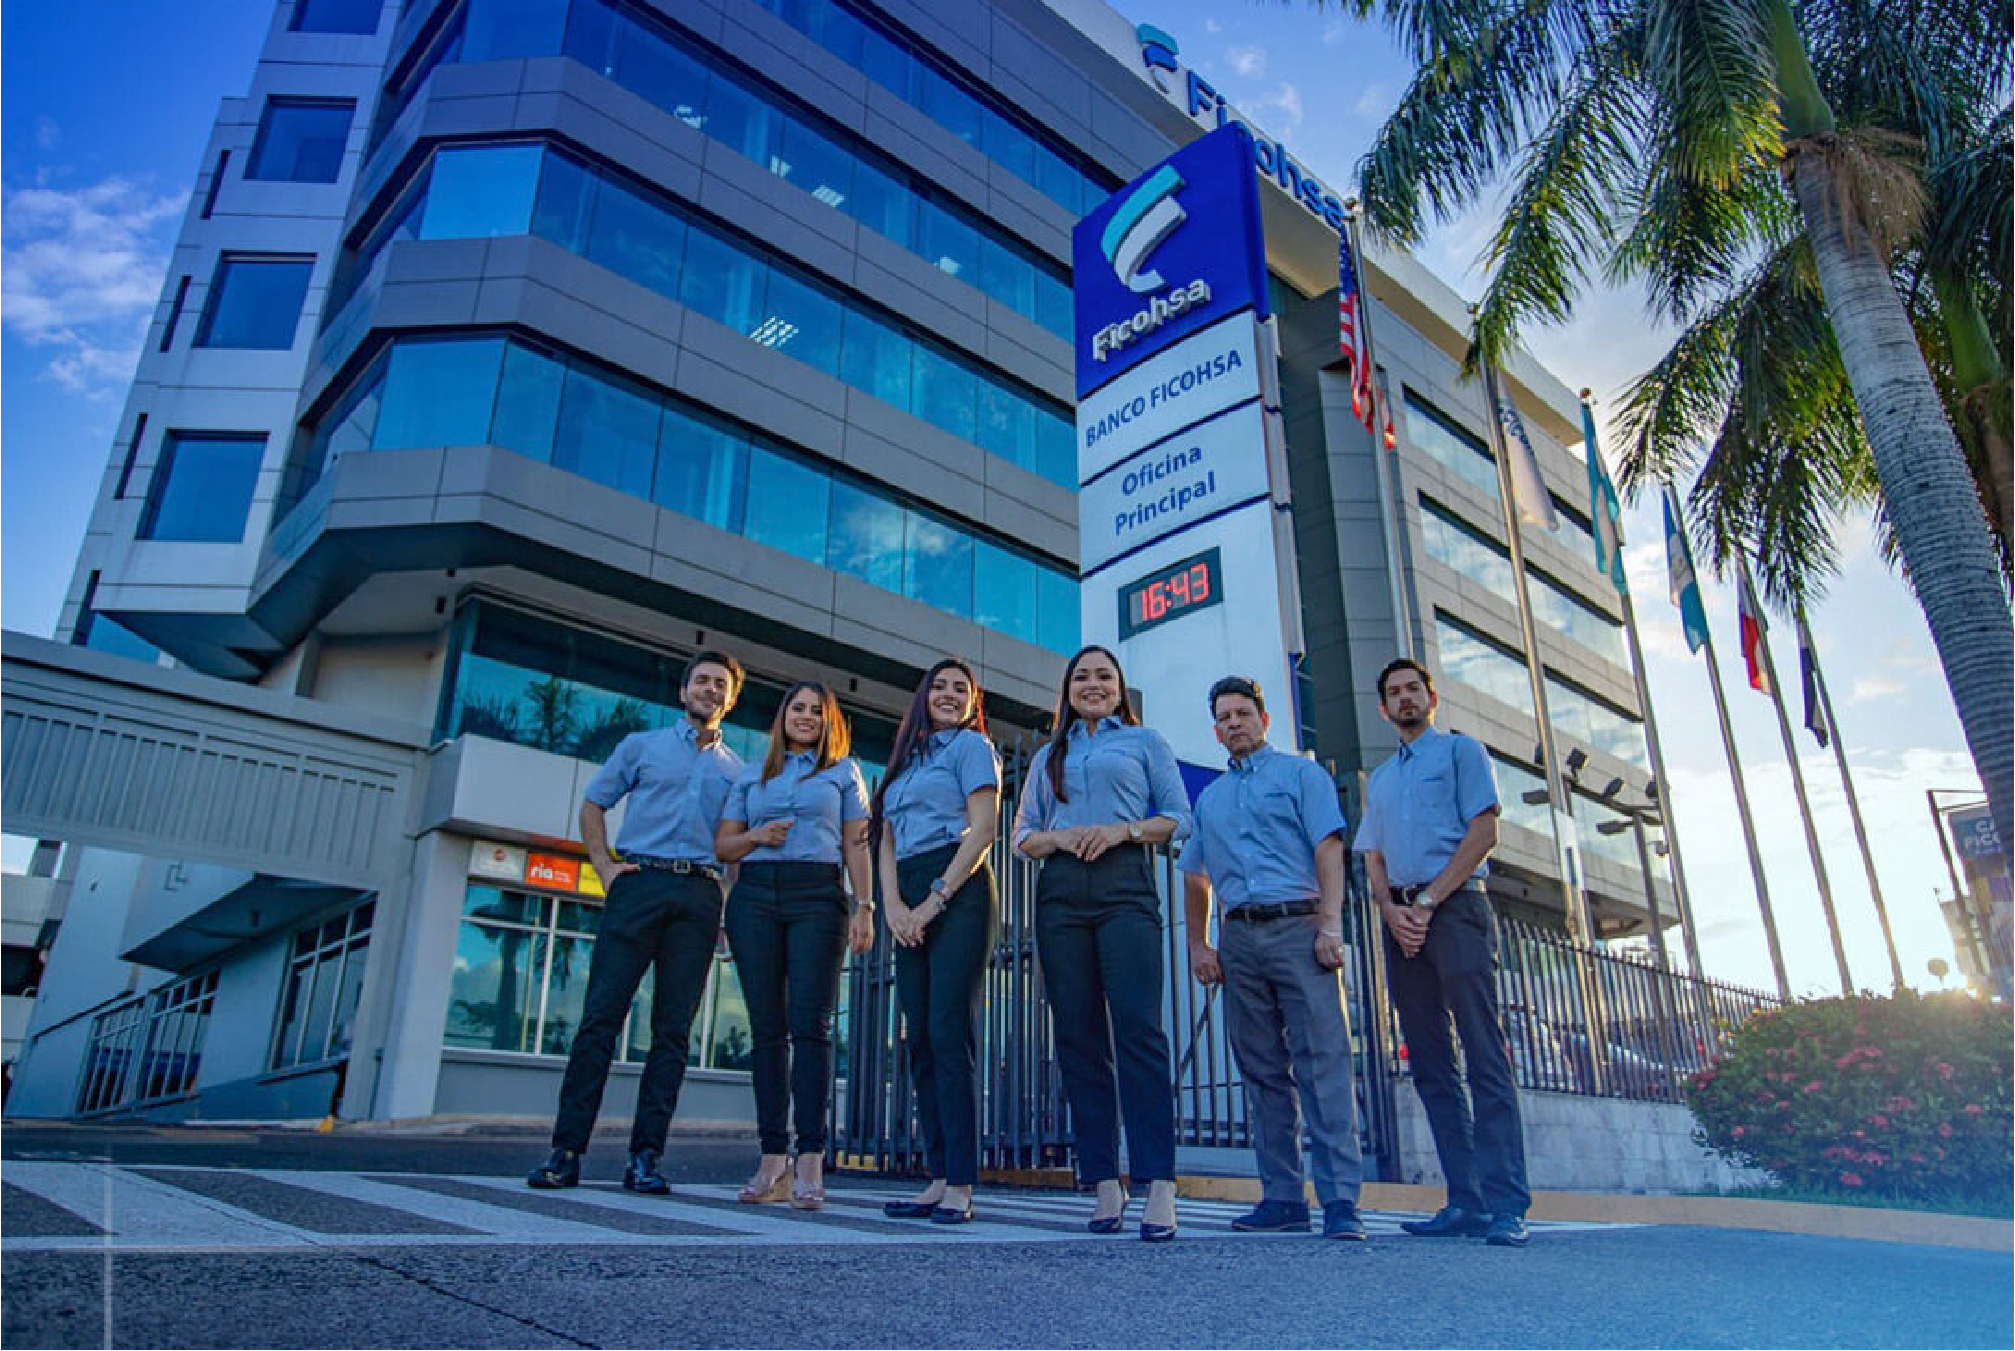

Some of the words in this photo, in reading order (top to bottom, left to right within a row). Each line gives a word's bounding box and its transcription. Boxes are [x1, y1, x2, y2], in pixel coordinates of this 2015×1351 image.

[1186, 69, 1344, 229] Fiohsa
[1093, 279, 1211, 362] Ficohsa
[1086, 397, 1146, 448] BANCO
[1151, 351, 1242, 408] FICOHSA
[1115, 471, 1215, 536] Principal
[1122, 447, 1202, 496] Oficina
[1142, 563, 1210, 621] 16:43
